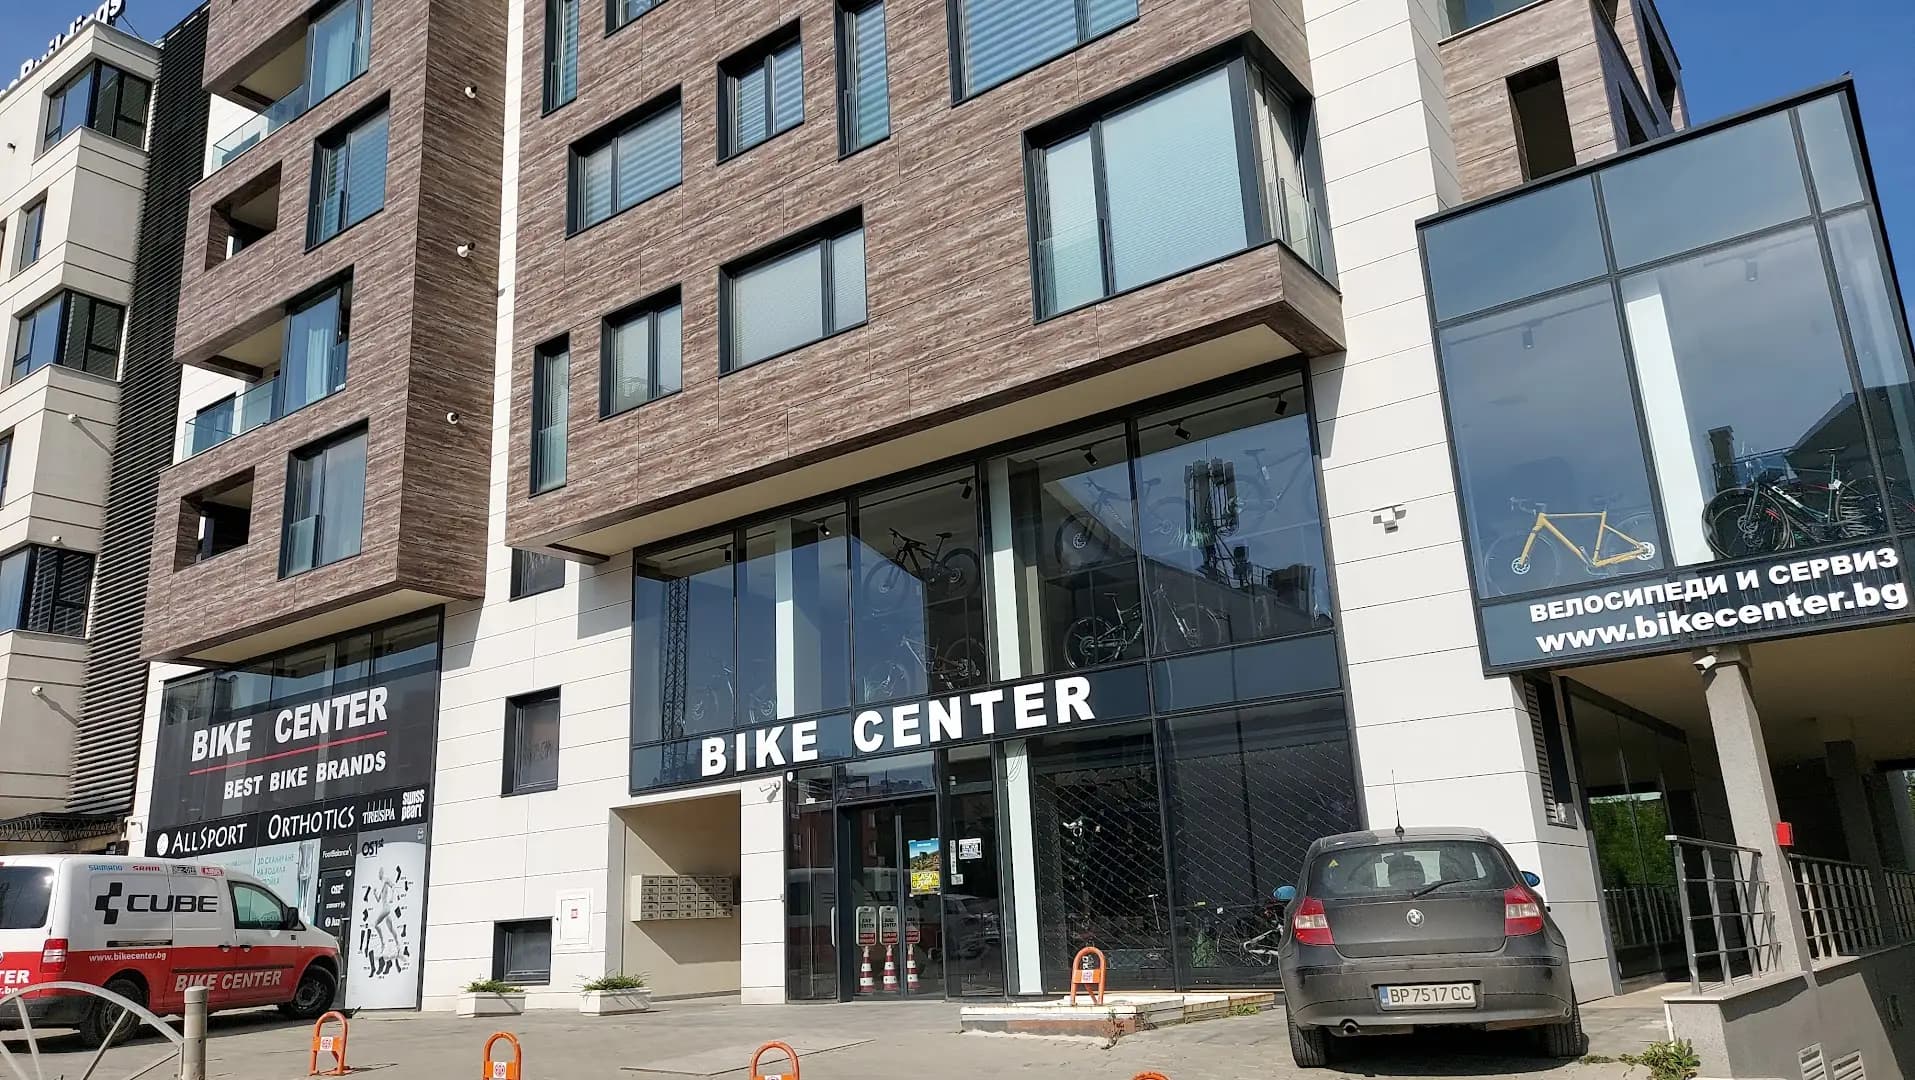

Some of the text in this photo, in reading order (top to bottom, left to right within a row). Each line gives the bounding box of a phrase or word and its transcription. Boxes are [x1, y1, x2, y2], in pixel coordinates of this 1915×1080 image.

[1529, 547, 1899, 624] ВЕЛОСИПЕДИ И СЕРВИЗ
[1536, 580, 1909, 653] www.bikecenter.bg
[191, 686, 389, 762] BIKE CENTER
[700, 676, 1097, 778] BIKE CENTER
[223, 750, 387, 801] BEST BIKE BRANDS
[268, 805, 356, 840] ORTHOTICS
[362, 807, 396, 825] TRESPA
[88, 864, 123, 872] SHIMANO
[127, 894, 218, 912] CUBE
[88, 951, 167, 962] www.bikecenter.bg
[174, 970, 282, 992] BIKE CENTER
[1390, 986, 1472, 1003] BP 7517 CC
